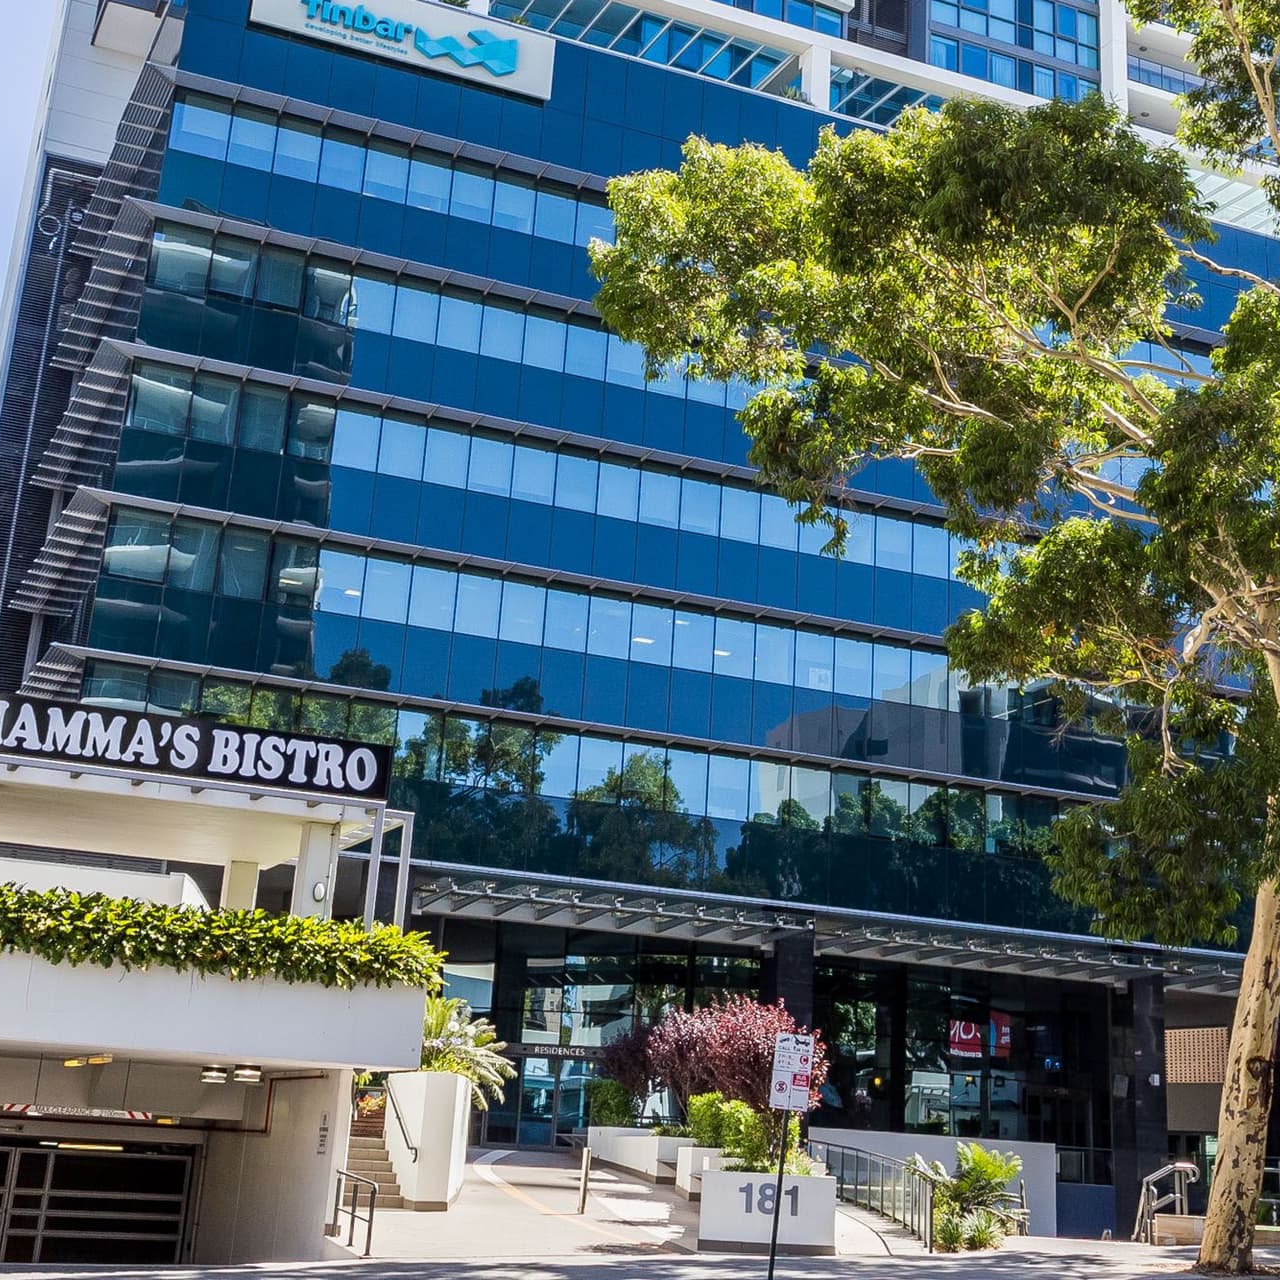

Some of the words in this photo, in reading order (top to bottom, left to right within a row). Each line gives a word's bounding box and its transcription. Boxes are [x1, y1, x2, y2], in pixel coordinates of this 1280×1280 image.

[208, 729, 377, 791] BISTRO
[534, 1046, 585, 1056] RESIDENCES
[739, 1183, 799, 1216] 181
